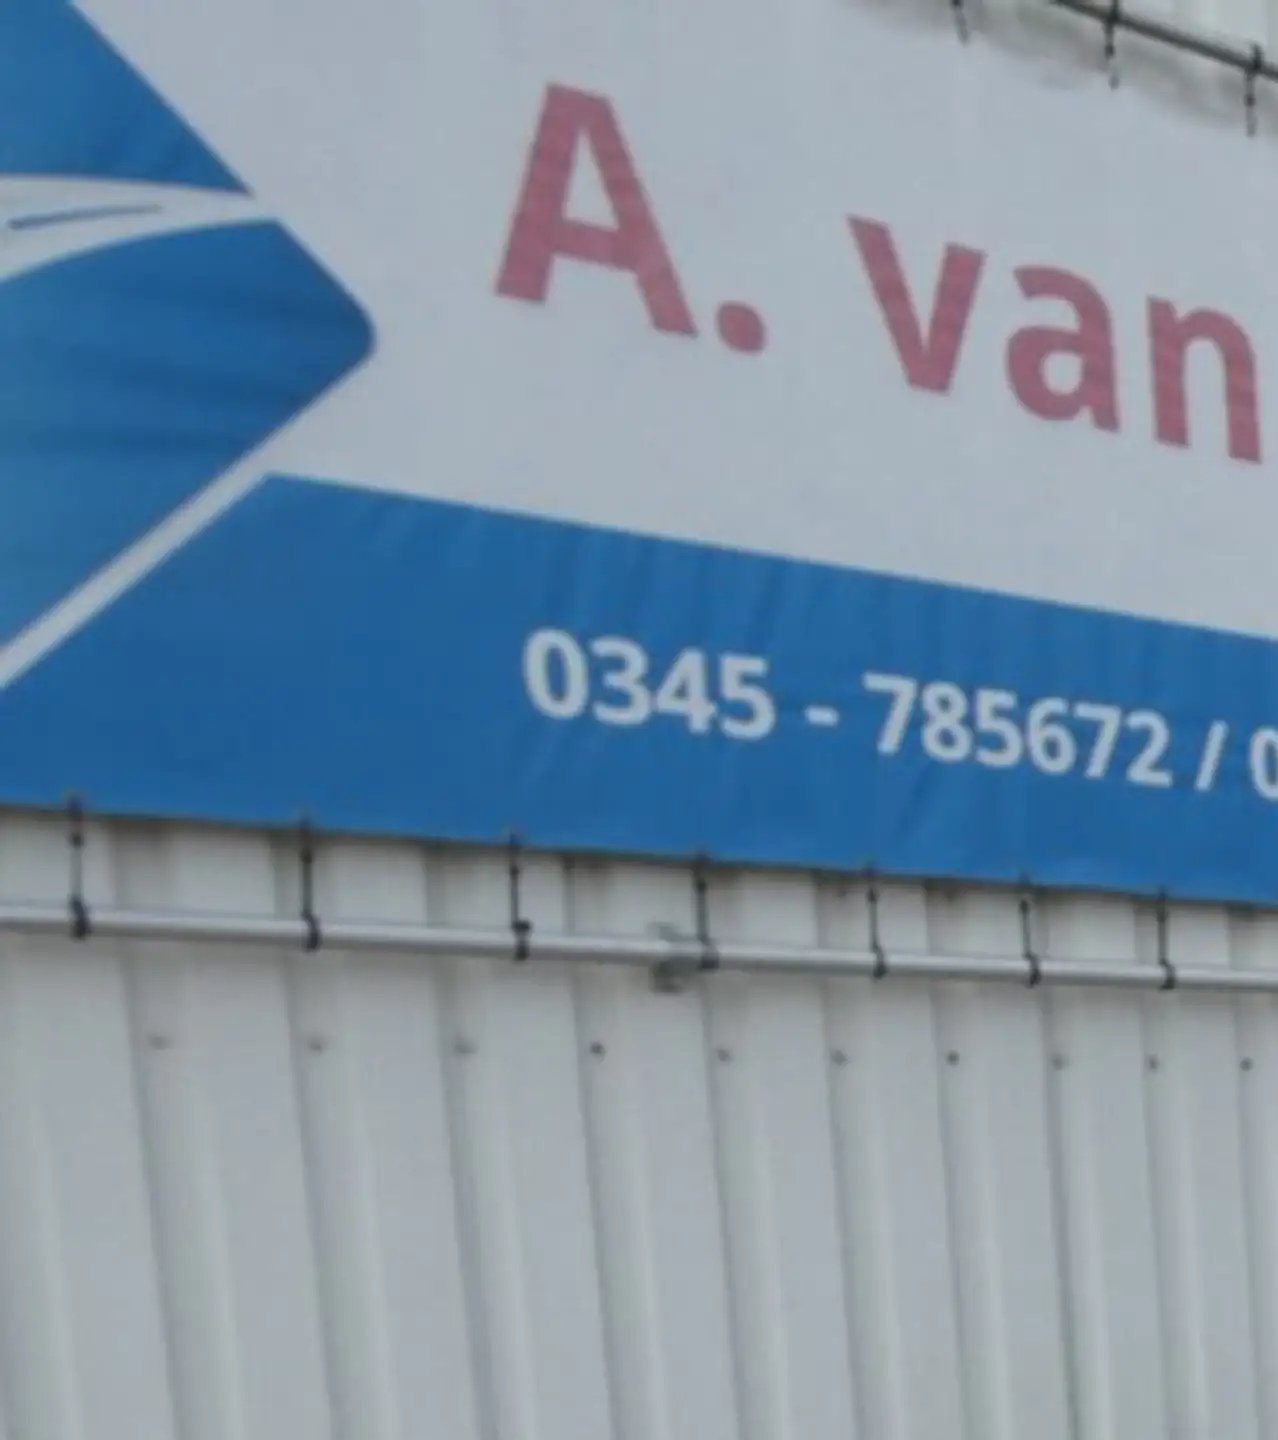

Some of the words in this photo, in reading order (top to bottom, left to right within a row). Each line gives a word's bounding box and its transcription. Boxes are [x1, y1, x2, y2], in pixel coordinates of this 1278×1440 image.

[494, 82, 767, 354] A.
[845, 214, 1262, 465] van
[524, 628, 776, 740] 0345
[862, 672, 1173, 788] 785672
